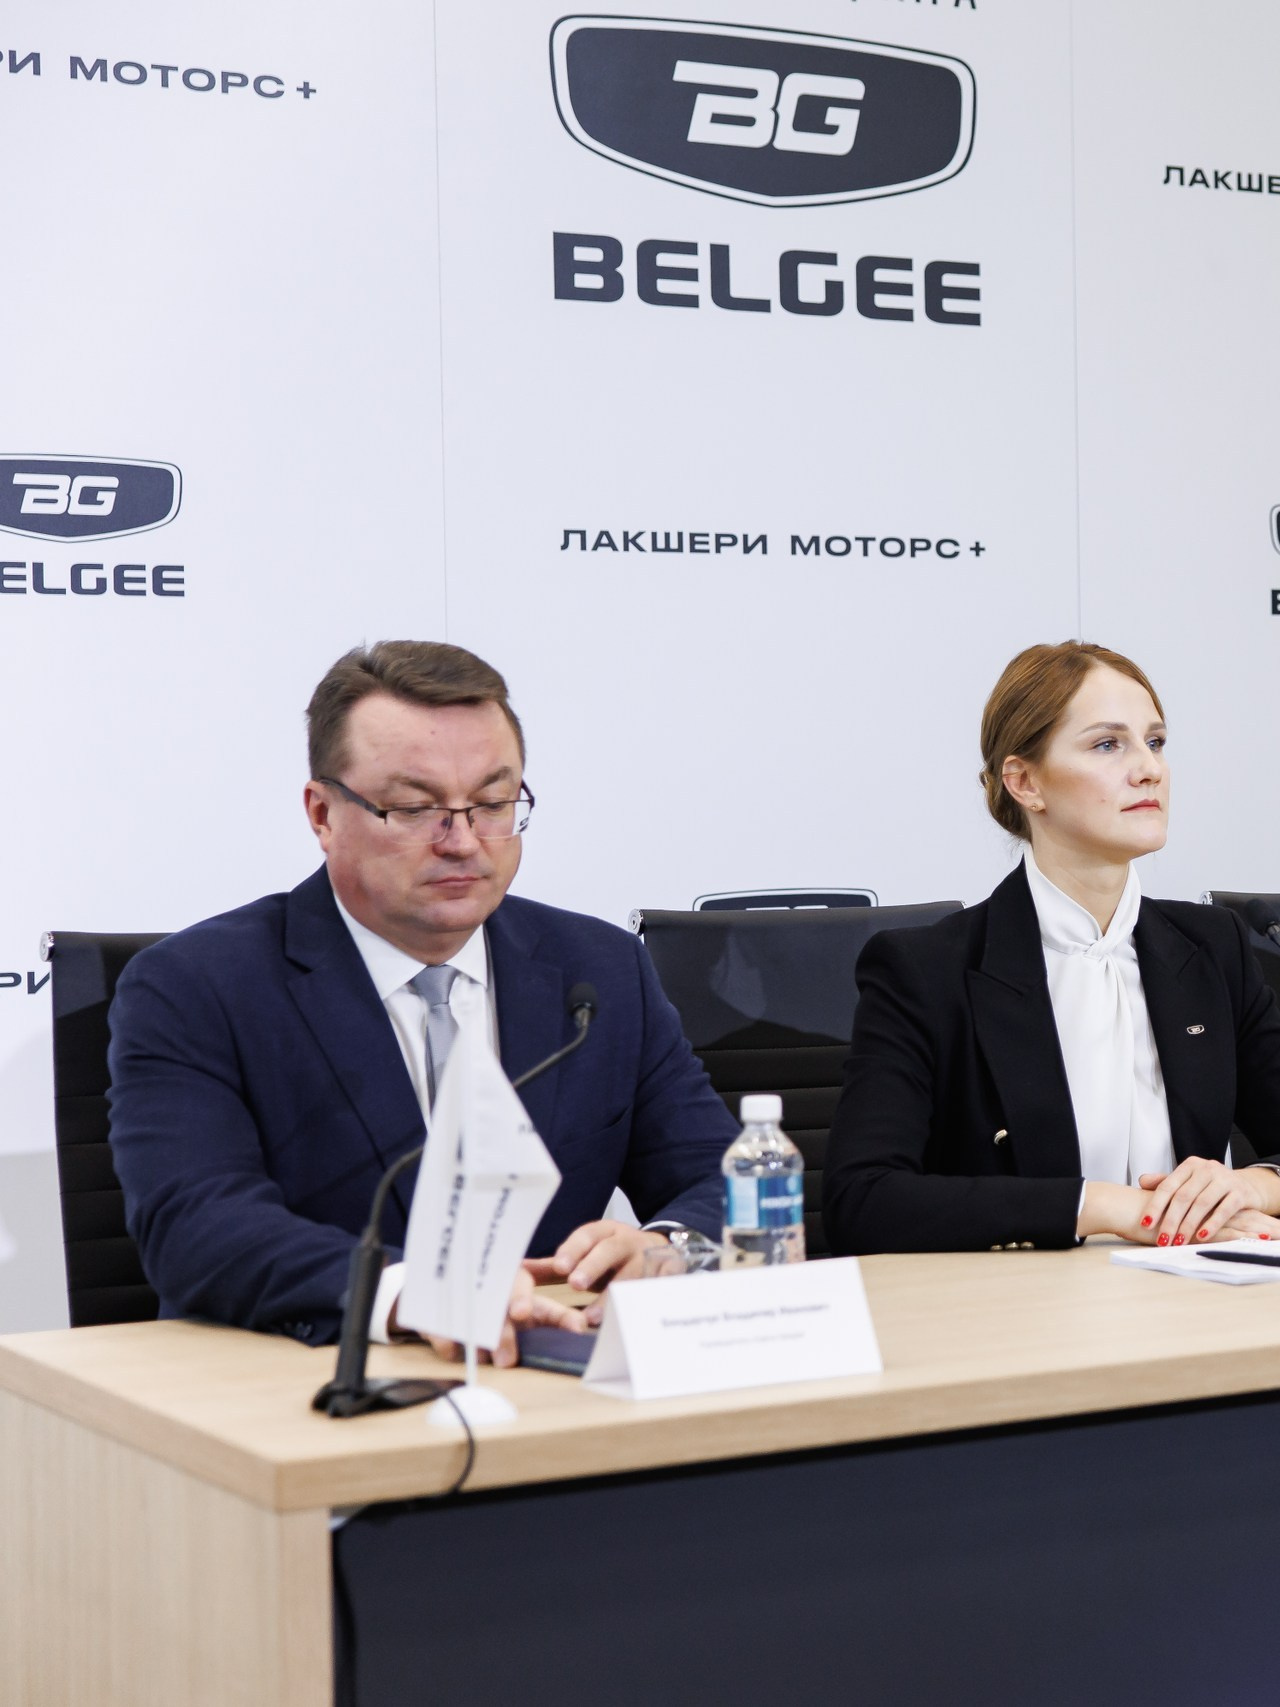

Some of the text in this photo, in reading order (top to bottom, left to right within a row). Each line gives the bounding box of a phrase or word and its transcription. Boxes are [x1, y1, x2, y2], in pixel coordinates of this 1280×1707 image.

[0, 50, 317, 99] И МОТОРС+
[672, 60, 866, 156] BG
[553, 232, 981, 326] BELGEE
[13, 472, 119, 516] BG
[561, 529, 986, 559] ЛАКШЕРИ МОТОРС+
